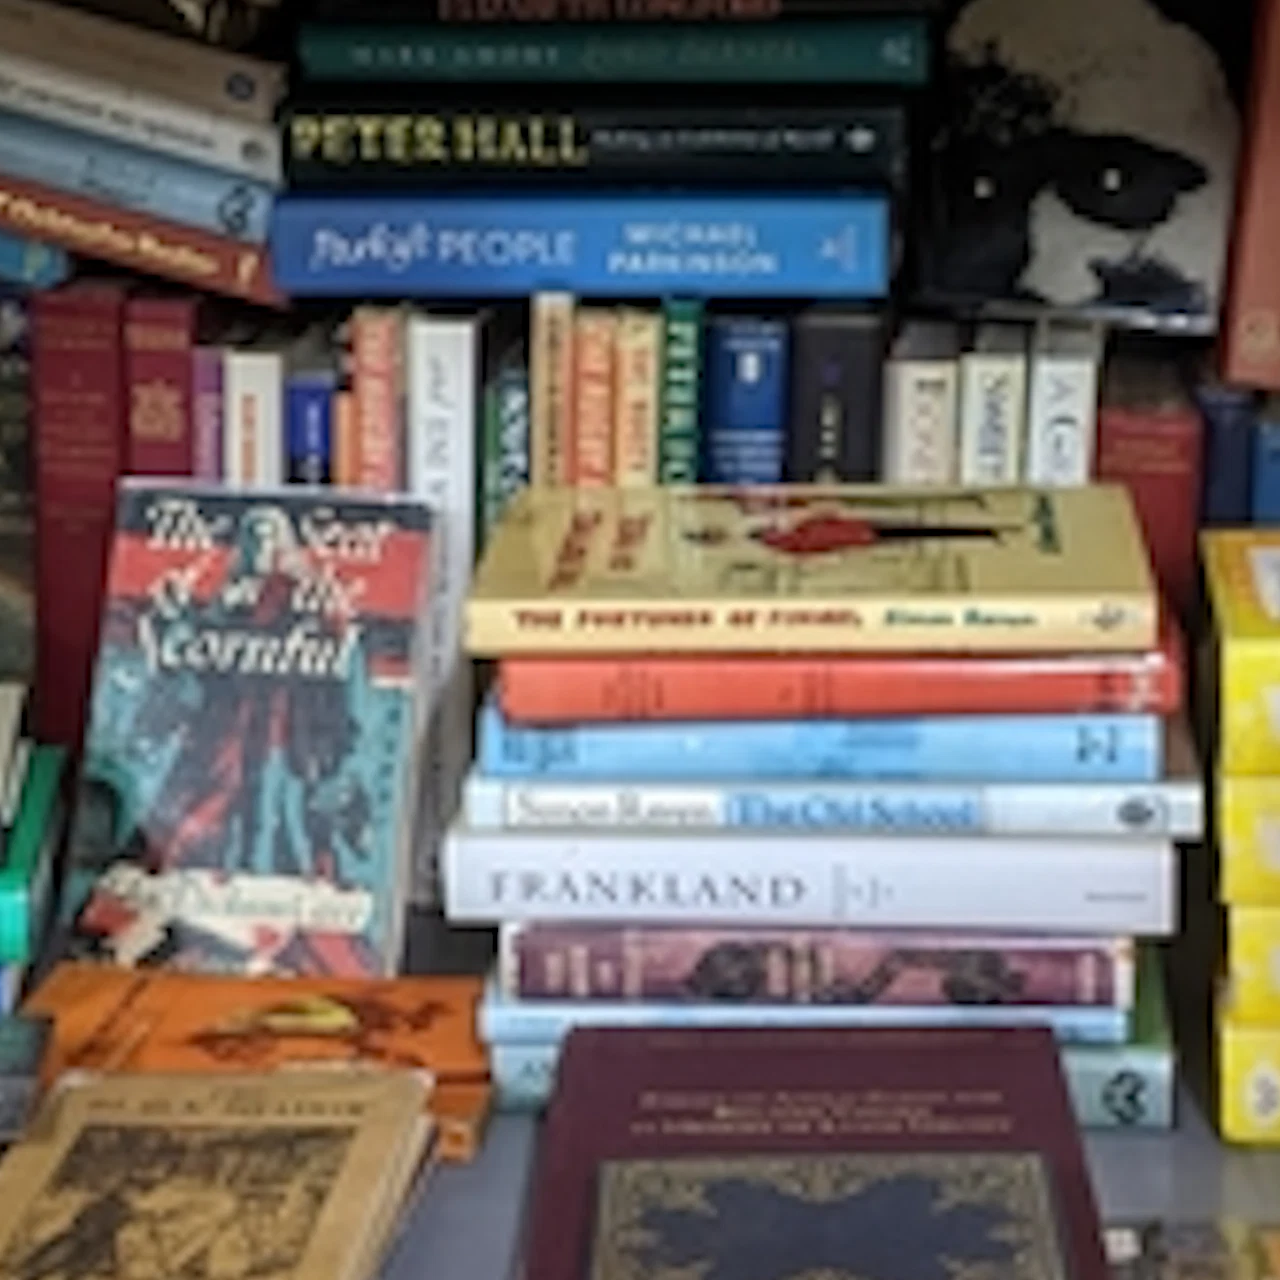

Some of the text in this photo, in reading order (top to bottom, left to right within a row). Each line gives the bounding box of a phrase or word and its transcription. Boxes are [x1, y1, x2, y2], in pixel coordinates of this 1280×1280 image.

[290, 113, 450, 165] PETER
[452, 113, 589, 168] HALL
[437, 228, 579, 268] PEOPLE
[623, 222, 759, 248] MICHAEL
[607, 250, 779, 278] PARKINSON
[145, 497, 222, 551] The
[512, 609, 564, 631] THE
[577, 608, 711, 630] FORTUNES
[516, 793, 615, 827] Simon
[730, 795, 793, 829] The
[870, 794, 977, 830] School
[489, 870, 807, 909] FRANKLAND
